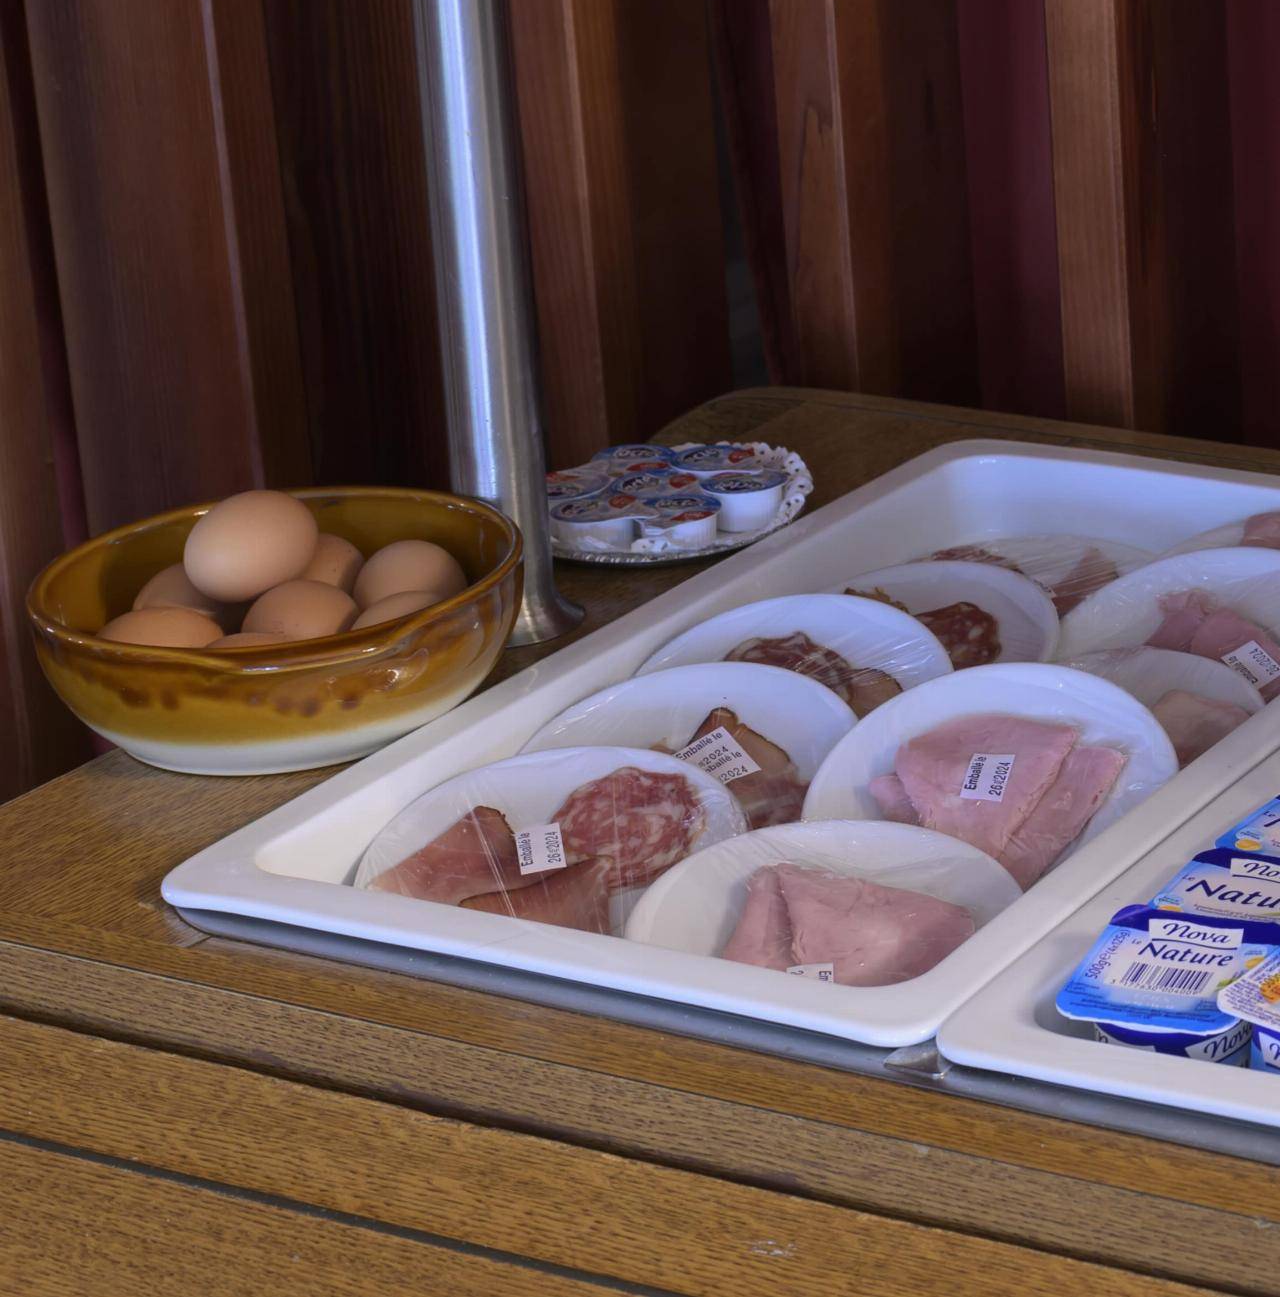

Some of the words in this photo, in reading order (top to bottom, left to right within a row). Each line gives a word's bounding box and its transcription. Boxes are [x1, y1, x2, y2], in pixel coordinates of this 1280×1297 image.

[713, 732, 722, 740] le
[1162, 922, 1232, 944] Nova
[1138, 942, 1234, 967] Nature
